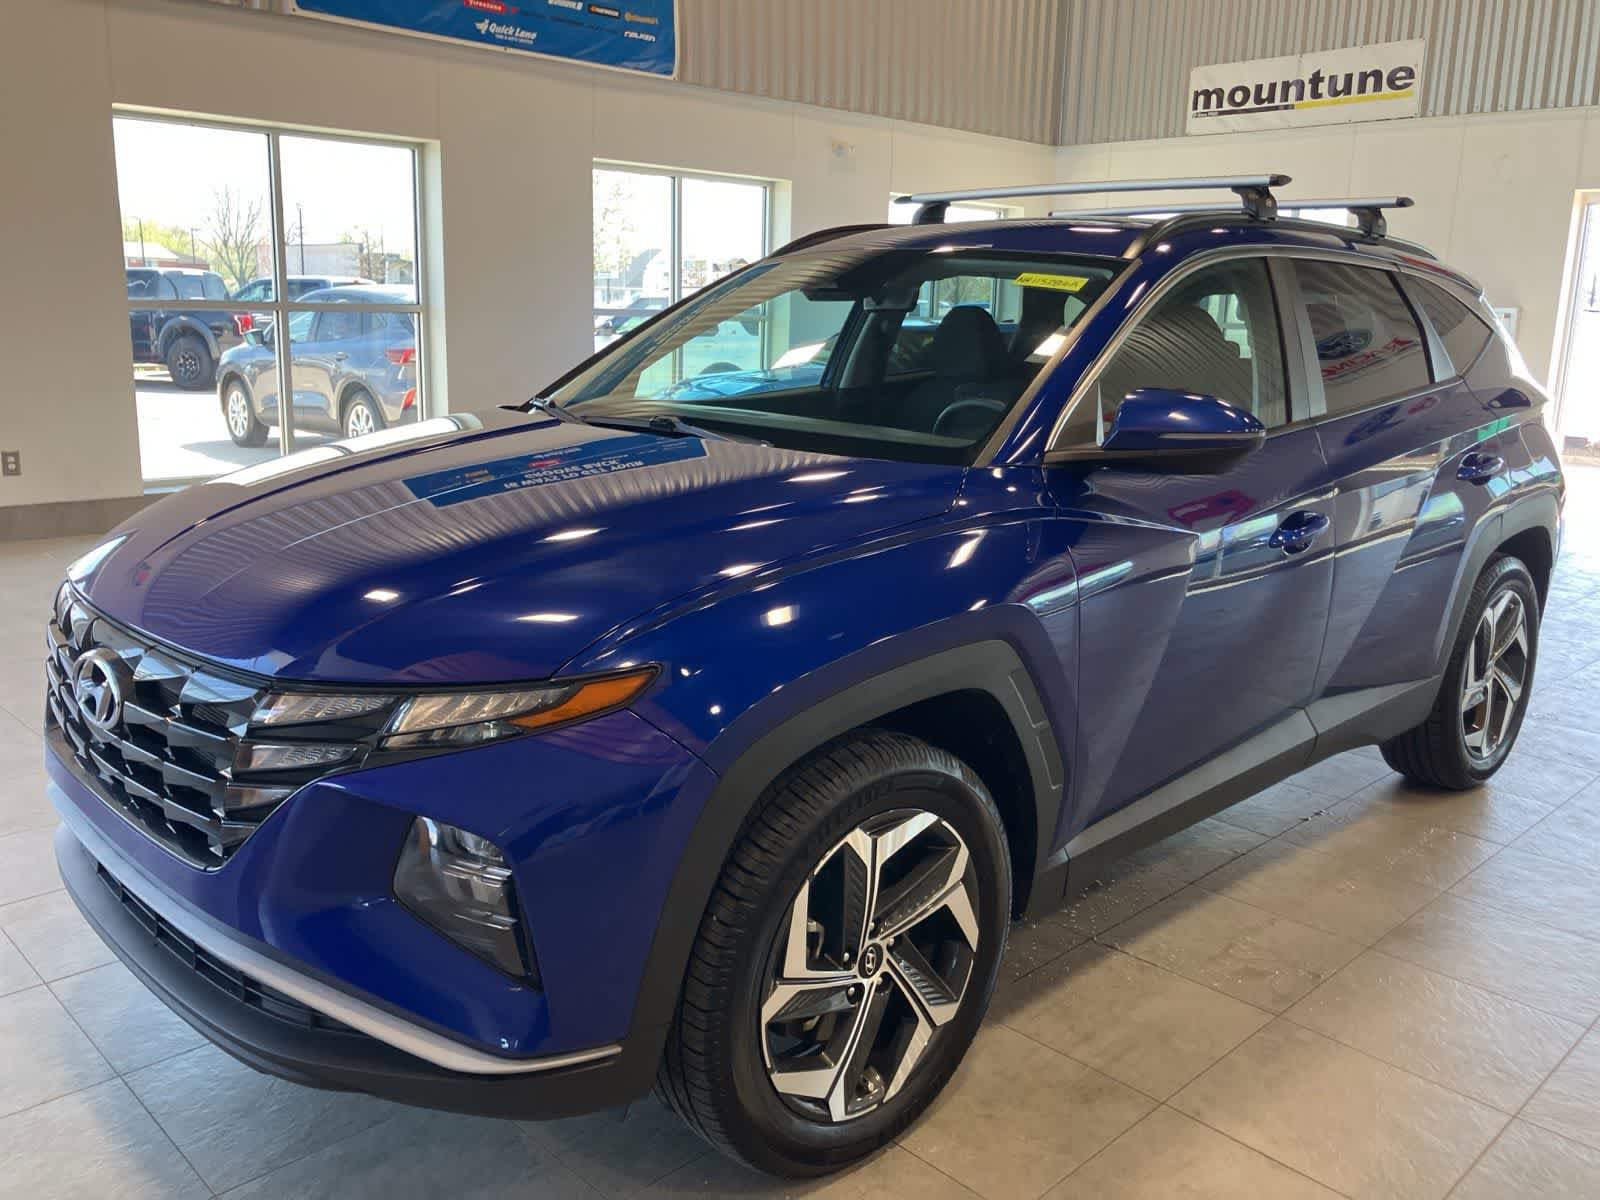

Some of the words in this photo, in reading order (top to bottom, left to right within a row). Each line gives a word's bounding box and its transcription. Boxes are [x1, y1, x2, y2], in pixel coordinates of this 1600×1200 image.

[489, 22, 514, 36] Quick
[515, 28, 538, 41] Lane
[1192, 66, 1416, 111] mountune
